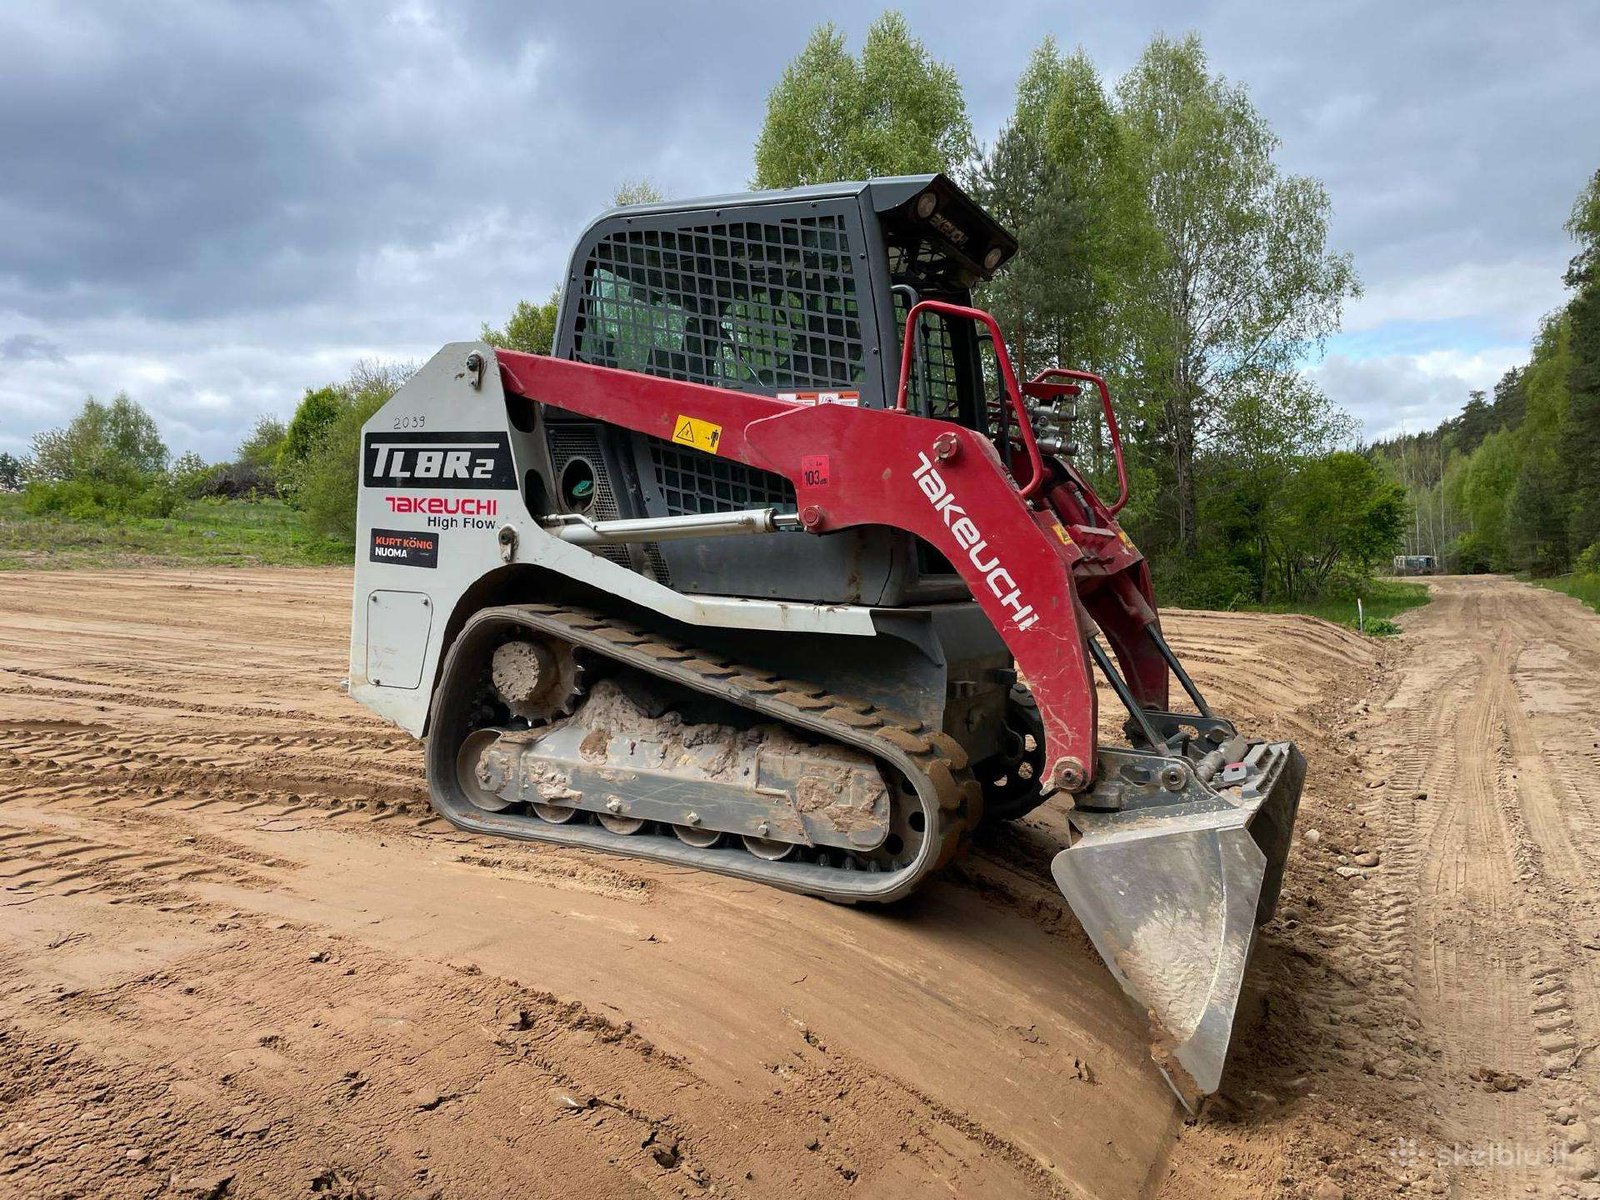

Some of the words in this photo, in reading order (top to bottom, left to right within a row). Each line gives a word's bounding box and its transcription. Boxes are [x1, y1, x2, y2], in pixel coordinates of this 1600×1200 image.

[394, 416, 425, 429] 2039
[370, 443, 499, 478] TL8R2
[427, 516, 458, 530] High
[463, 517, 496, 529] Flow
[375, 536, 402, 546] KURT
[403, 536, 433, 550] KÖNIG
[375, 546, 408, 558] NUOMA
